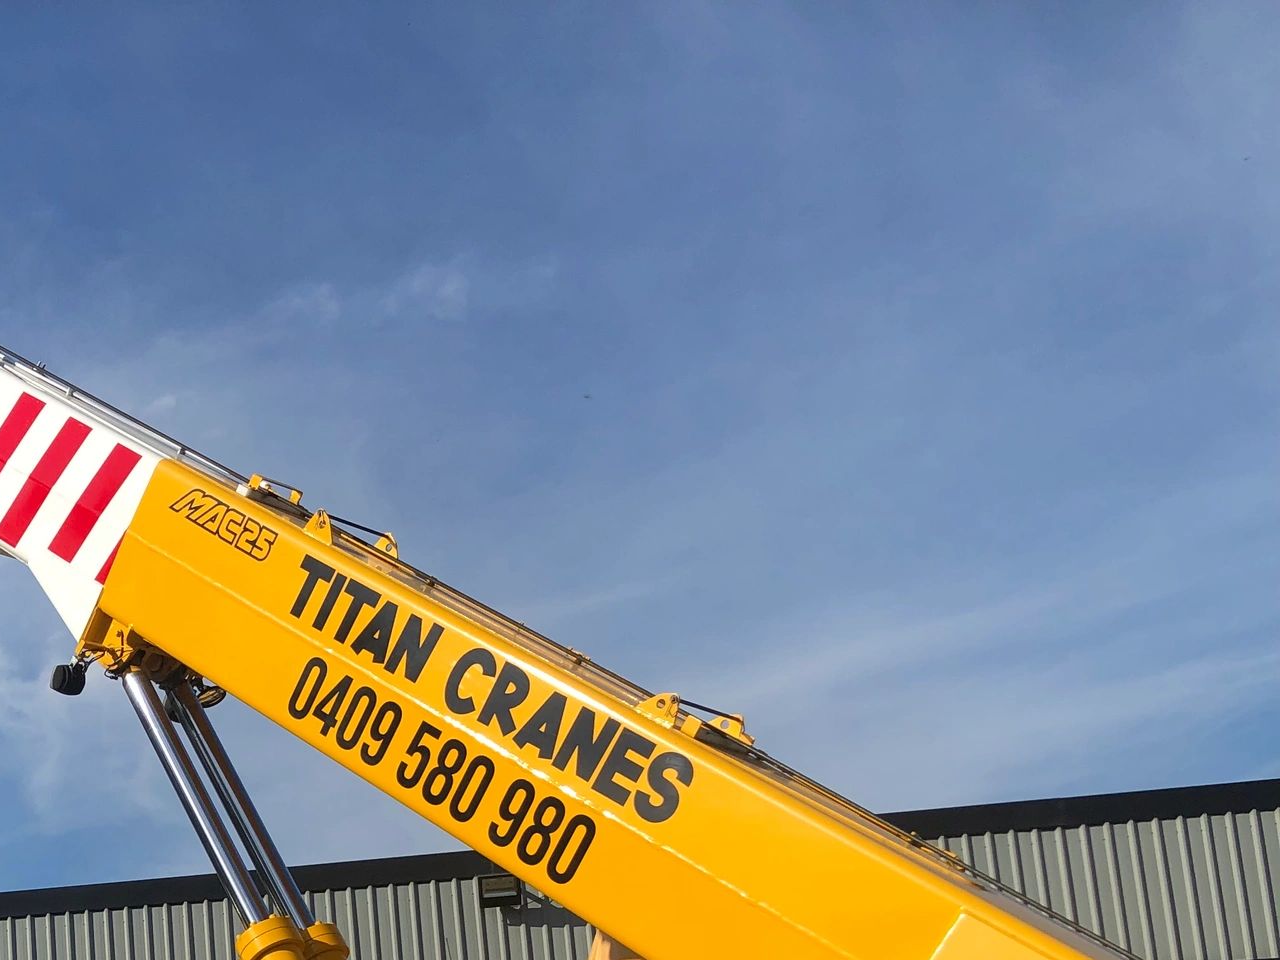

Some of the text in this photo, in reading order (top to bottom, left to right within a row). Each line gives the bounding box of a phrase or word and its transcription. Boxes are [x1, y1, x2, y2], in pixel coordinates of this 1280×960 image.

[287, 657, 596, 884] 0409 580 980
[289, 553, 694, 823] TITAN CRANES
